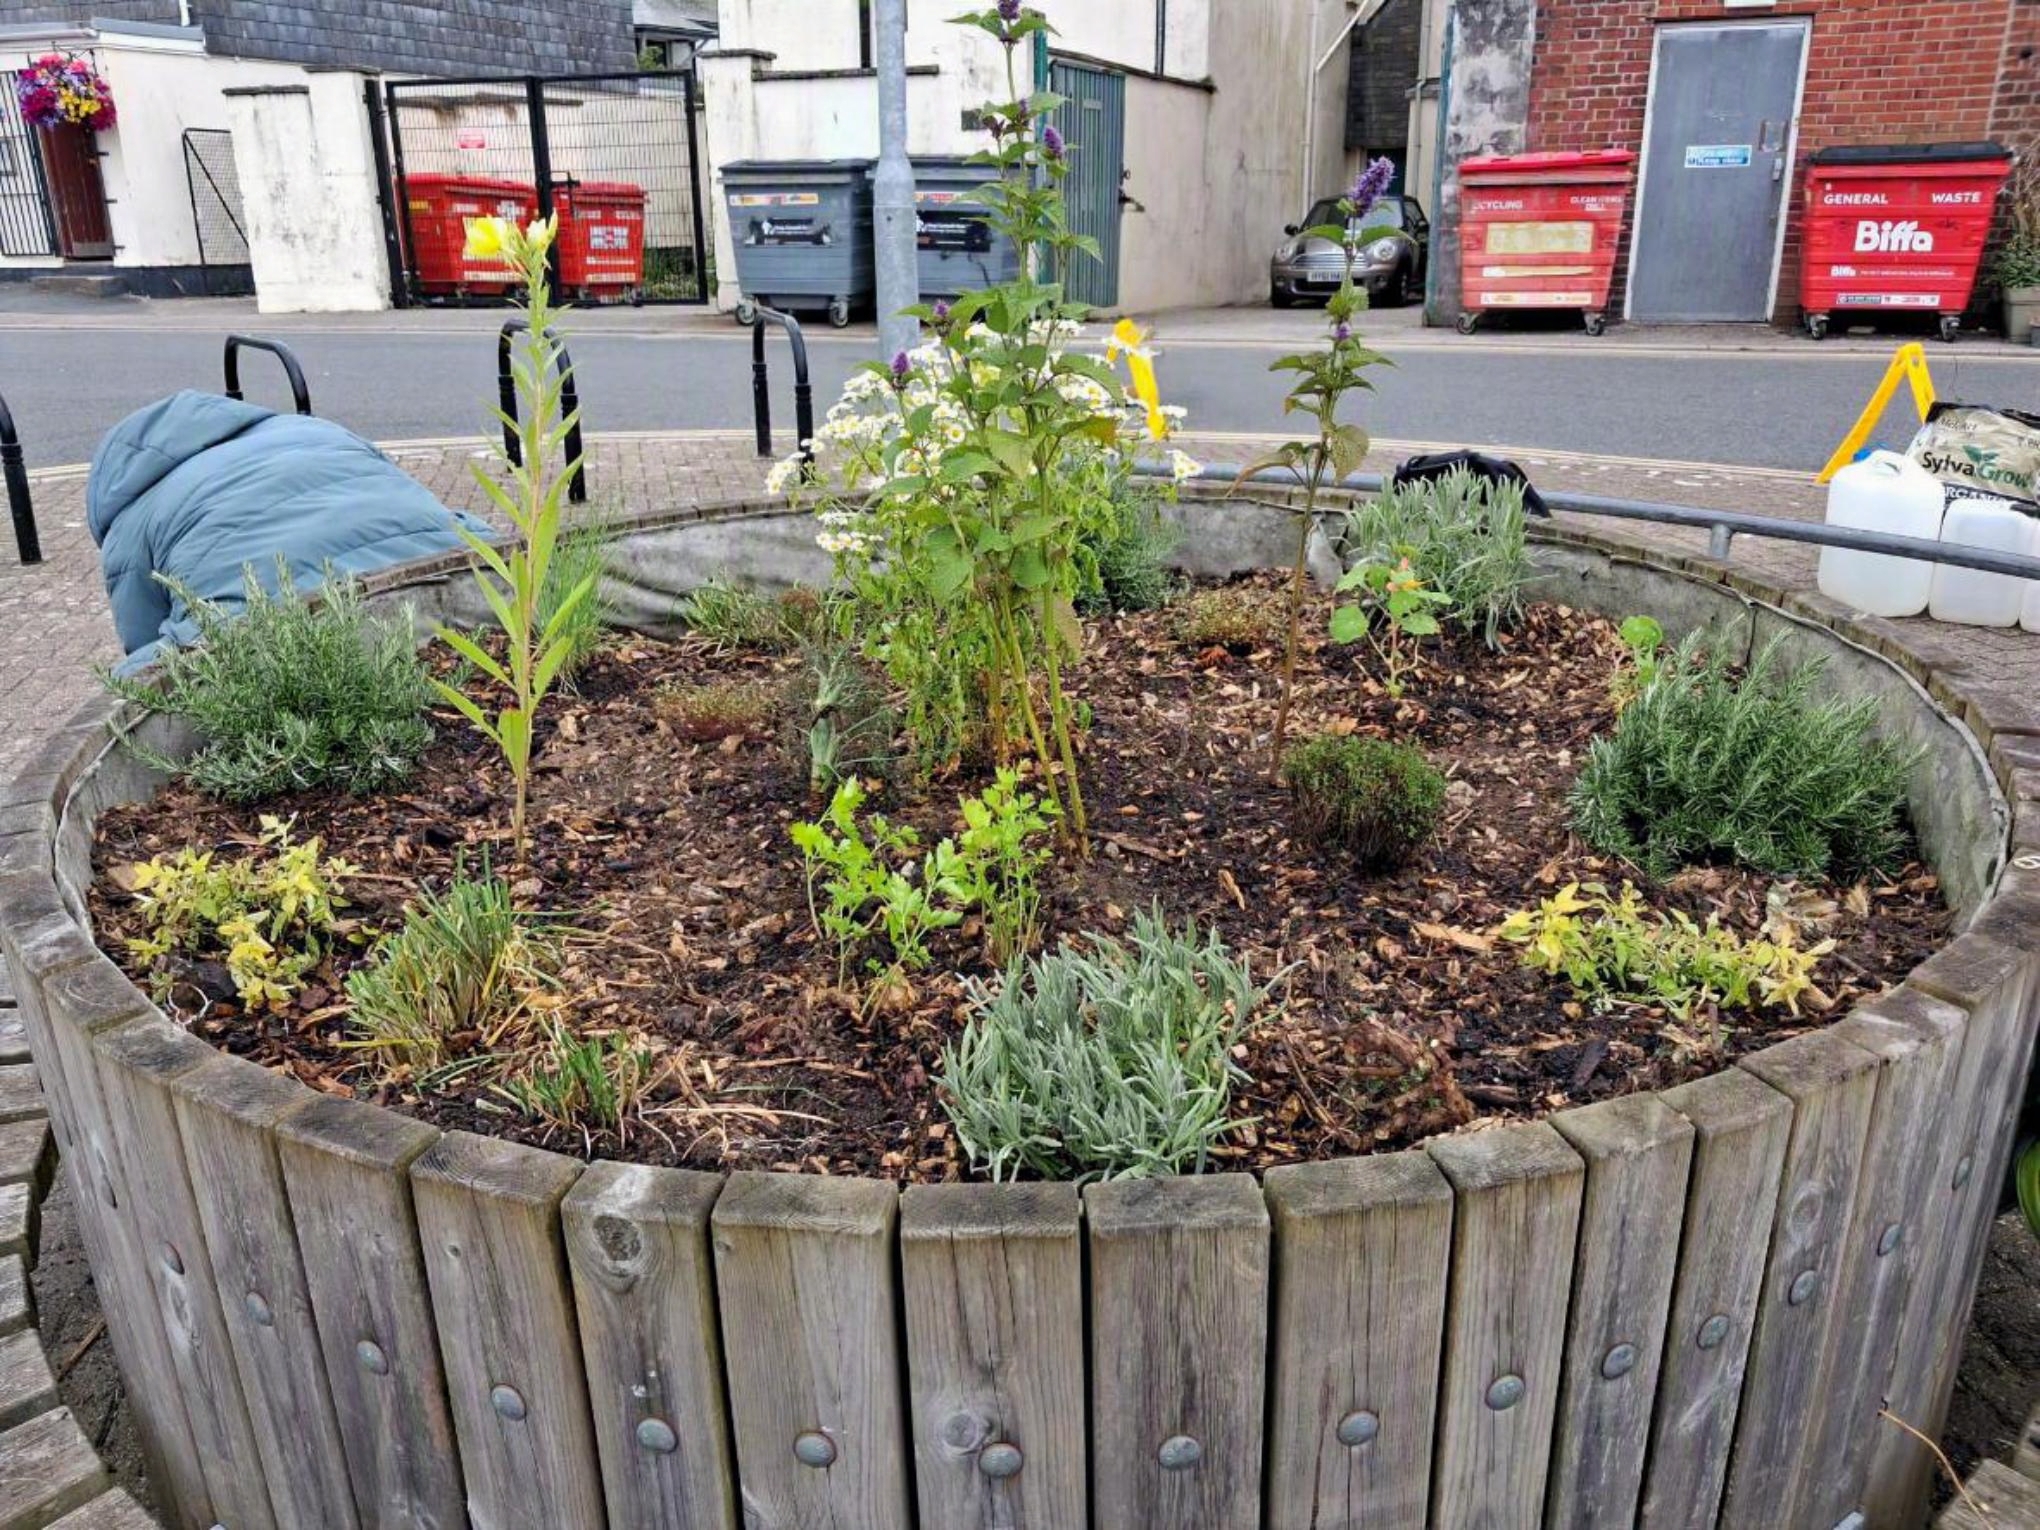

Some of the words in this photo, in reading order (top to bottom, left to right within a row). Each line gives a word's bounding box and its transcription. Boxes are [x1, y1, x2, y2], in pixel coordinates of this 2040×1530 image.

[1824, 193, 1888, 204] GENERAL
[1932, 192, 1981, 203] WASTE
[1854, 220, 1934, 252] Biffa
